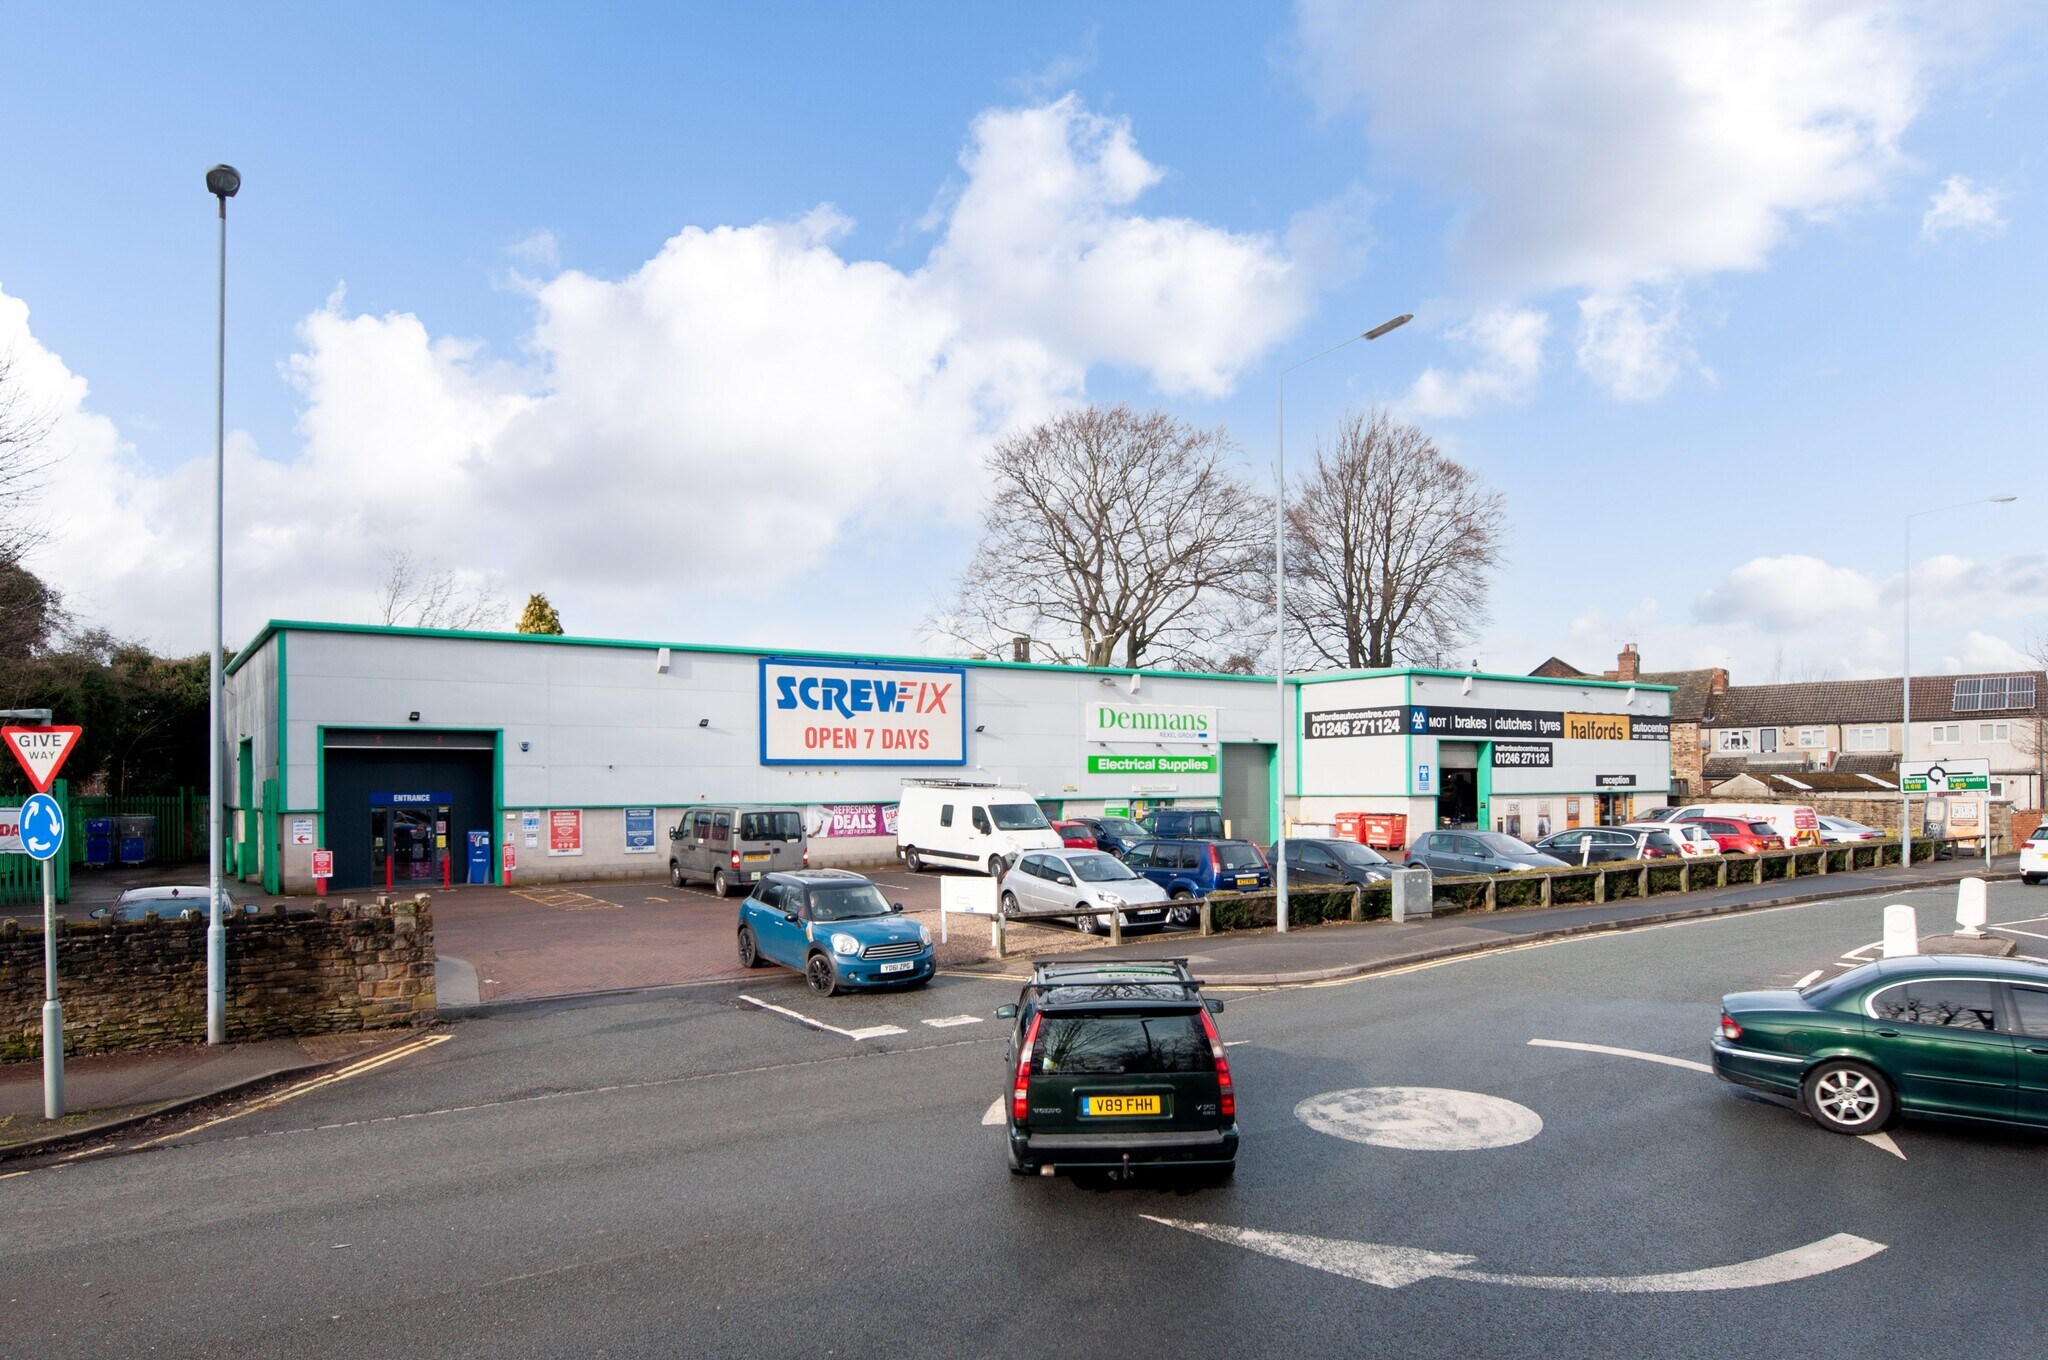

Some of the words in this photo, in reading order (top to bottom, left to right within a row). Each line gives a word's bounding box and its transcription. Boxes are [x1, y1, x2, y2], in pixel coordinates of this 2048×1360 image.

[776, 675, 953, 720] SCREWFIX
[1098, 707, 1208, 731] Denmans
[1311, 709, 1401, 722] halfordsautocentres.com
[1311, 721, 1350, 737] 01246
[1352, 717, 1401, 735] 271124
[1428, 717, 1447, 728] MOT
[1454, 715, 1487, 729] brakes
[1494, 716, 1533, 731] clutches
[1539, 719, 1561, 734] tyres
[1570, 720, 1624, 740] halfords
[1632, 722, 1669, 734] autocentre
[18, 734, 62, 748] GIVE
[804, 726, 857, 749] OPEN
[863, 728, 875, 749] 7
[881, 728, 929, 750] DAYS
[28, 751, 56, 760] WAY
[1495, 752, 1520, 764] 01246
[1521, 752, 1550, 764] 271124
[1097, 758, 1156, 770] Electrical
[1158, 758, 1209, 773] Supplies
[1602, 775, 1630, 786] reception
[393, 794, 431, 802] ENTRANCE
[834, 805, 877, 815] REFRESHING
[834, 814, 877, 829] DEALS
[1096, 1098, 1123, 1112] V89
[1126, 1098, 1153, 1111] FHH
